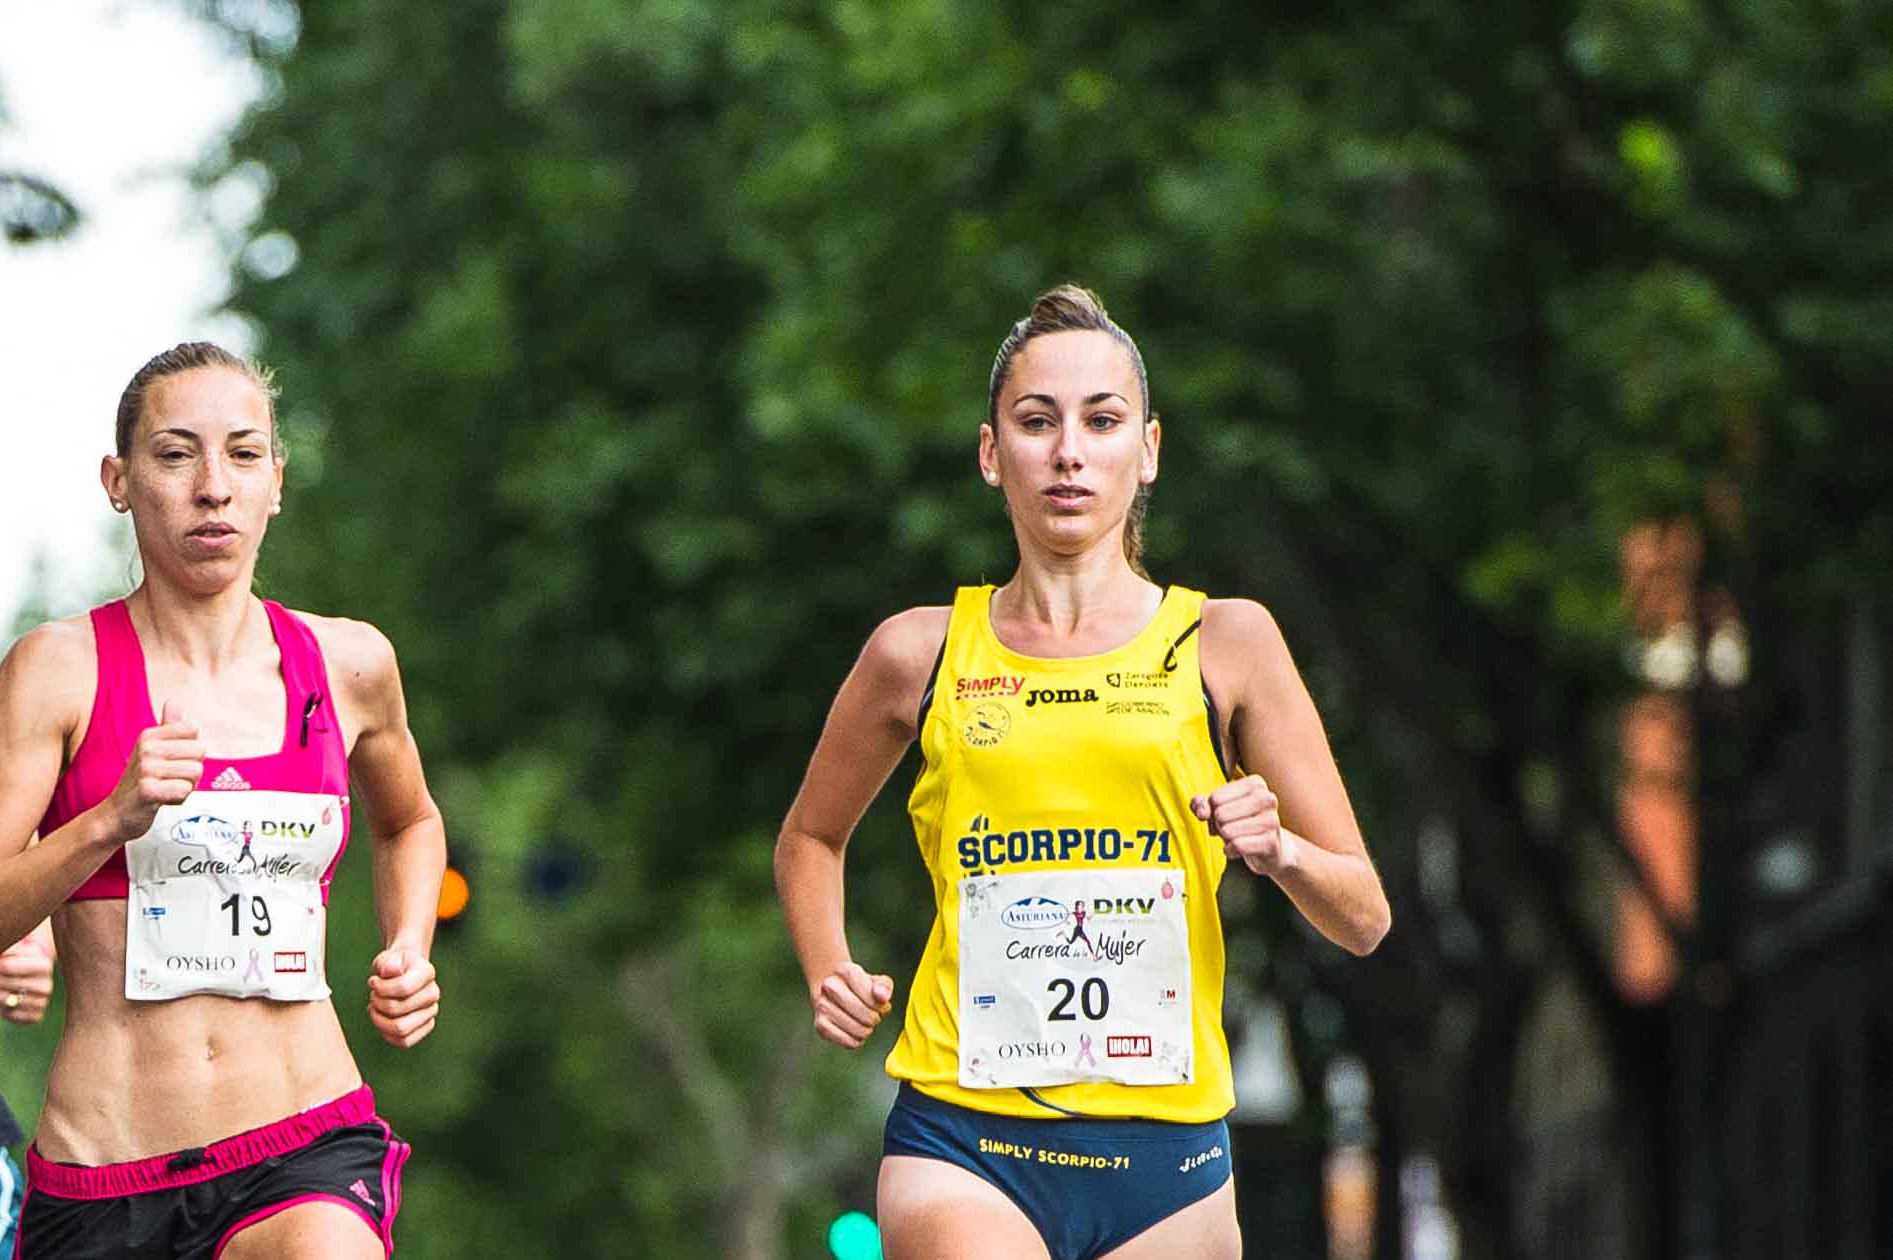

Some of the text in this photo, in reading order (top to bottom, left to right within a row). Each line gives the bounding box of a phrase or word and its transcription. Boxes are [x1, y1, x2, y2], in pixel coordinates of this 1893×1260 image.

[261, 821, 316, 838] DKV
[958, 829, 1171, 868] SCORPIO-71
[221, 893, 272, 936] 19
[1094, 898, 1156, 914] DKV
[166, 955, 236, 971] OYSHO
[1006, 940, 1071, 960] Carrera
[1096, 930, 1147, 965] Mujer
[1047, 977, 1109, 1022] 20
[998, 1041, 1066, 1058] OYSHO
[979, 1138, 1130, 1169] SIMPLY SCORPIO-71
